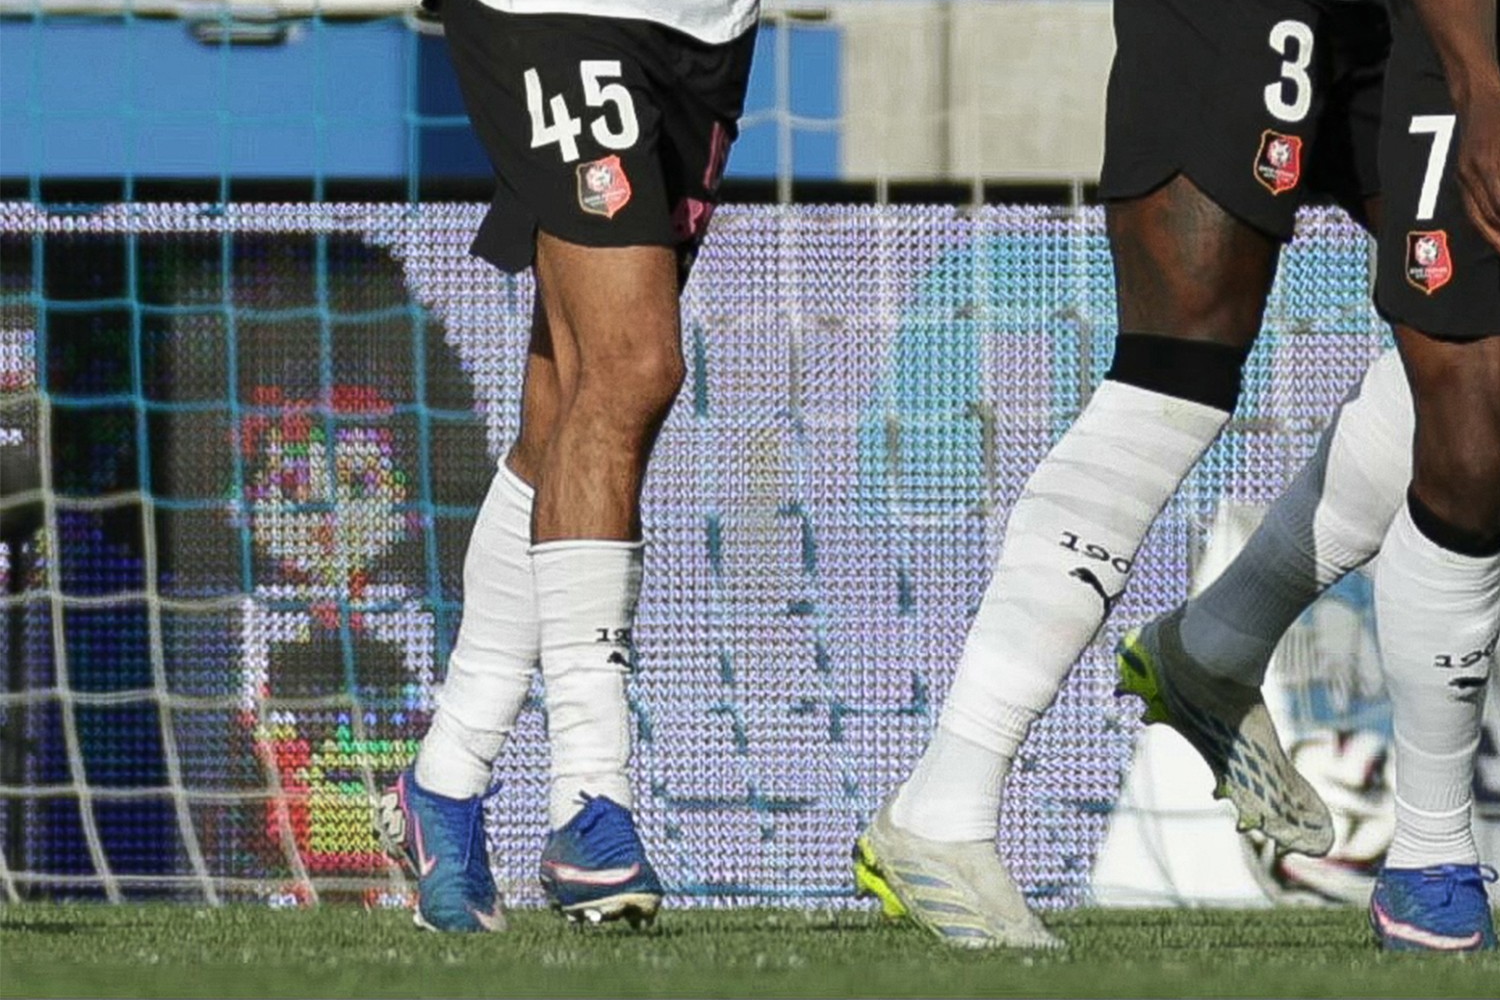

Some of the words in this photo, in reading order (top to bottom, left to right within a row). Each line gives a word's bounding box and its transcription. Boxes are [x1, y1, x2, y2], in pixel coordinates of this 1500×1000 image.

[523, 60, 640, 163] 45
[1263, 19, 1315, 123] 3
[1408, 114, 1456, 220] 7
